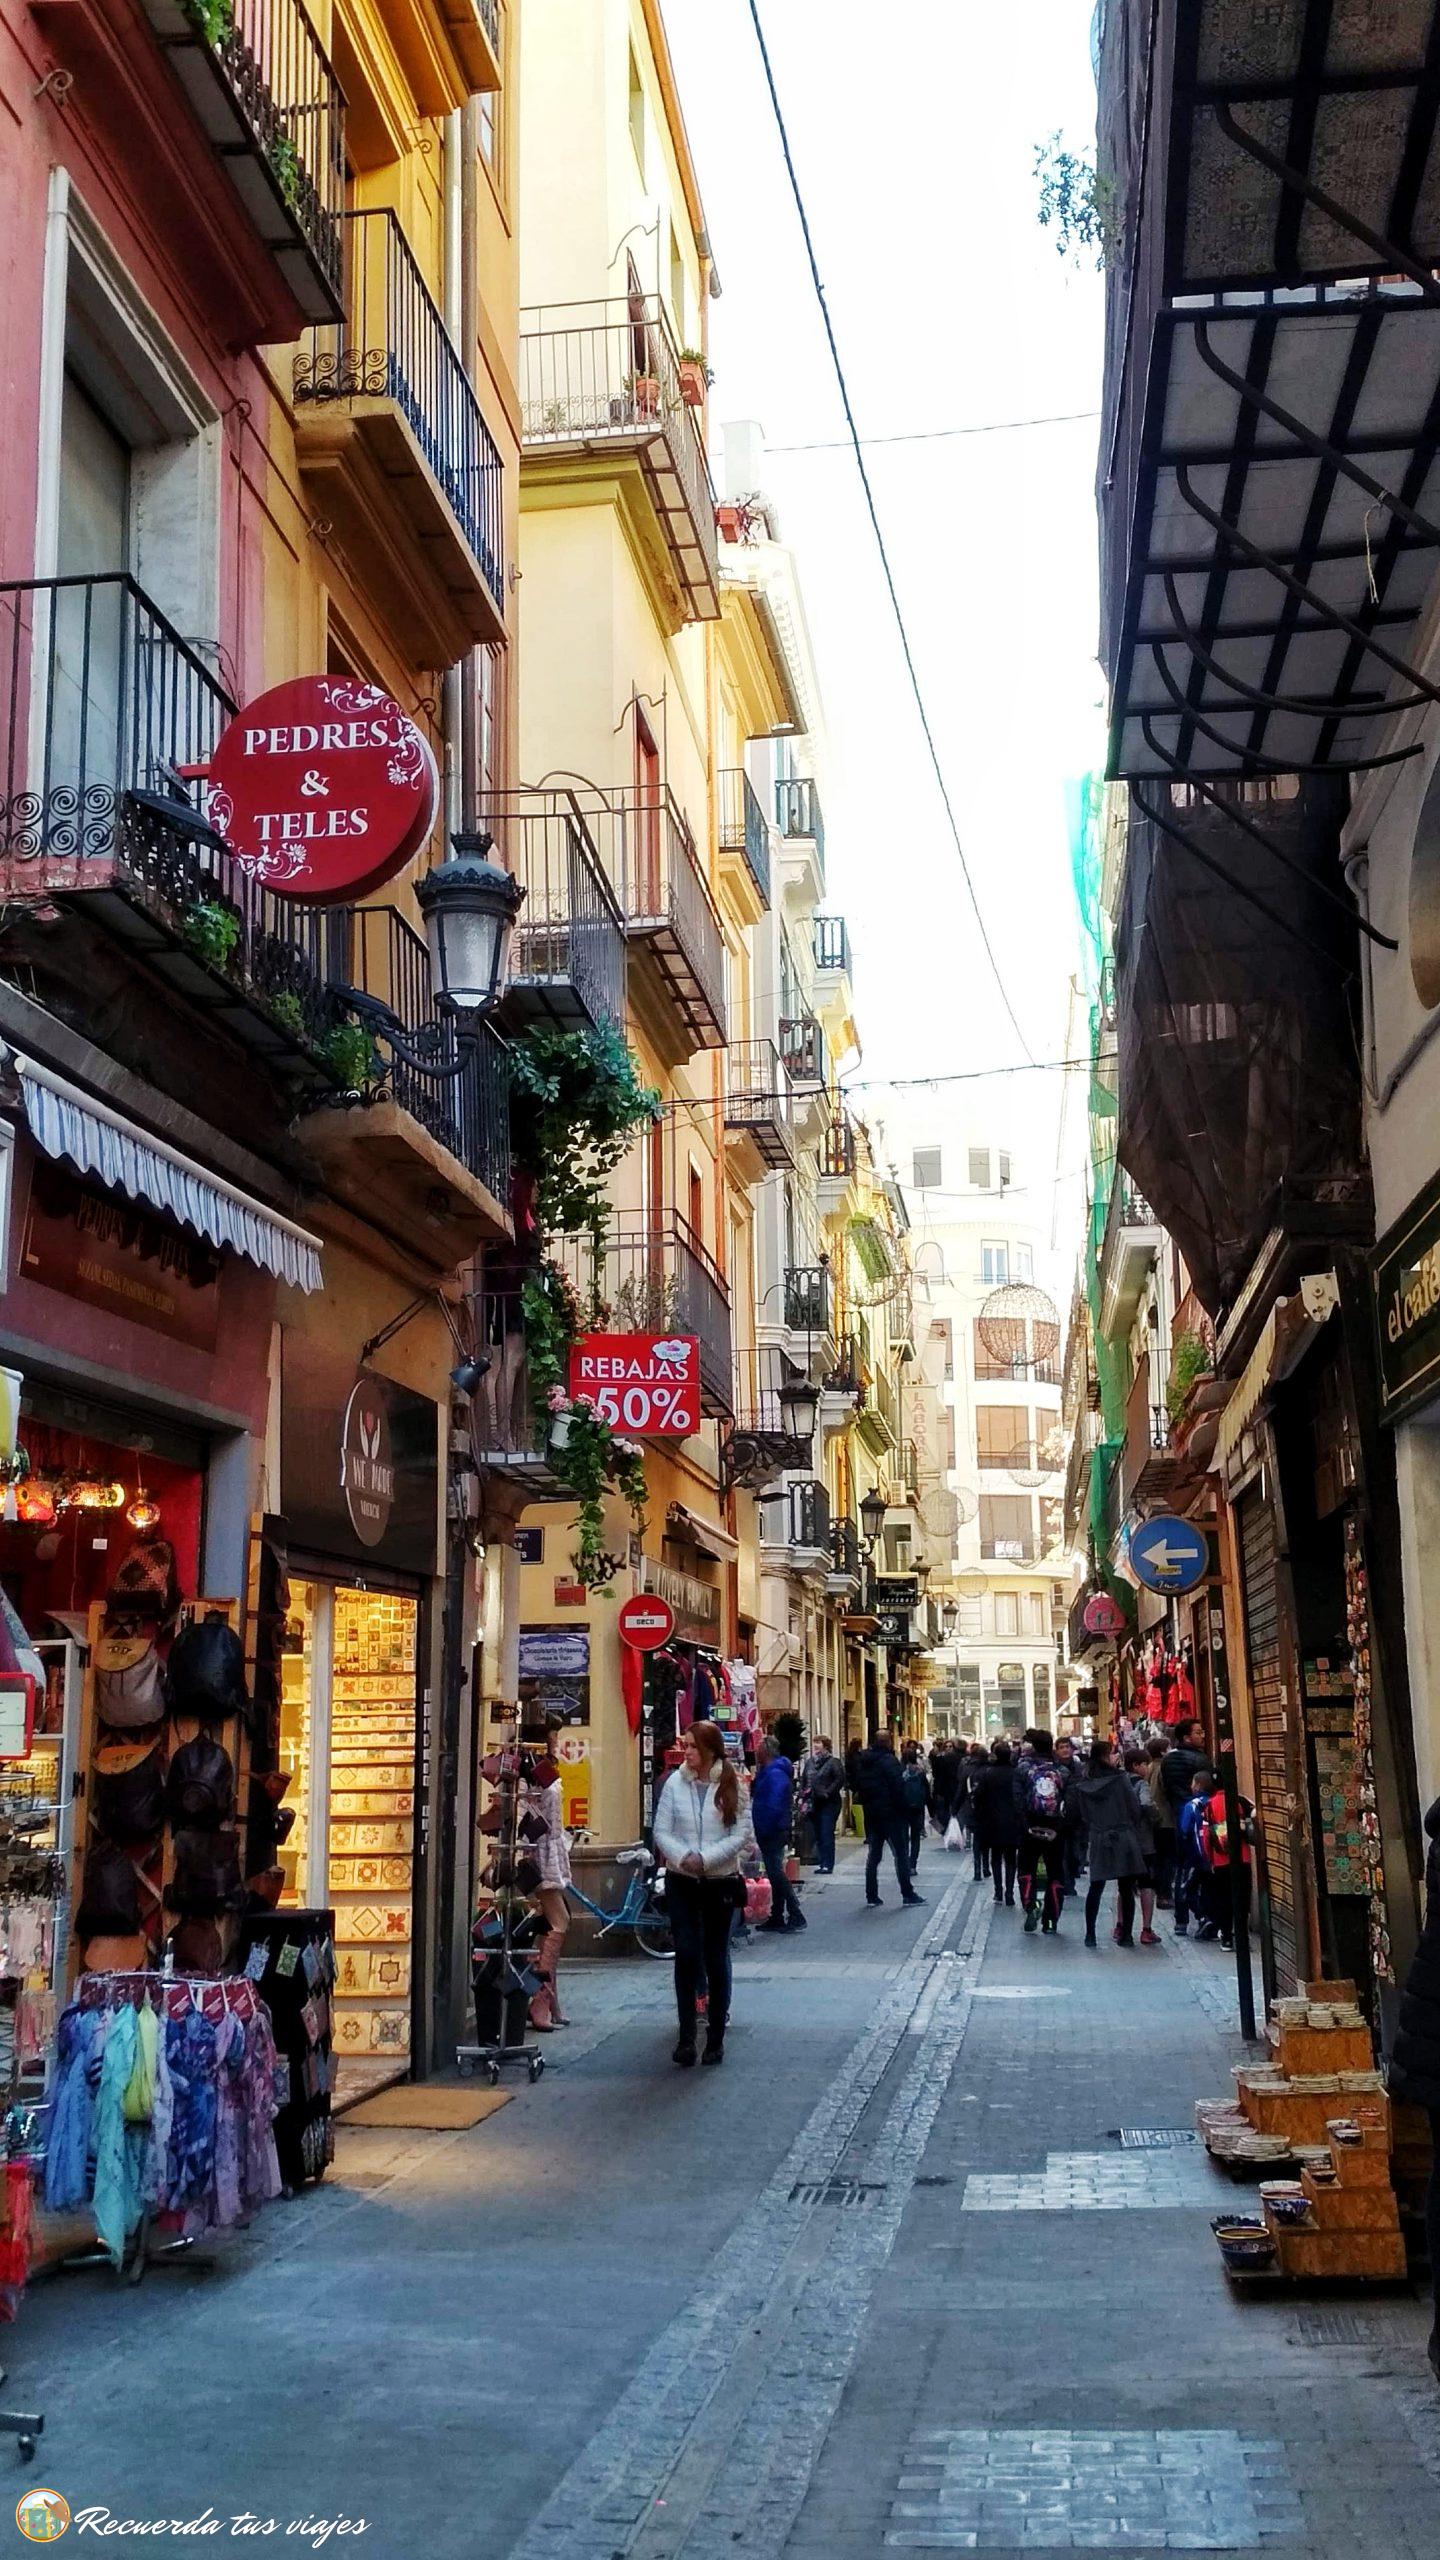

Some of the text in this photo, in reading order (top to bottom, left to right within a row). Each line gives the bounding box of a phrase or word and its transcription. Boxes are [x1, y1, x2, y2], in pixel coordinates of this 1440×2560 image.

[243, 718, 389, 756] PEDRES
[300, 769, 330, 796] &
[253, 807, 369, 841] TELES
[1388, 1289, 1403, 1343] el
[581, 1357, 689, 1380] REBAJAS
